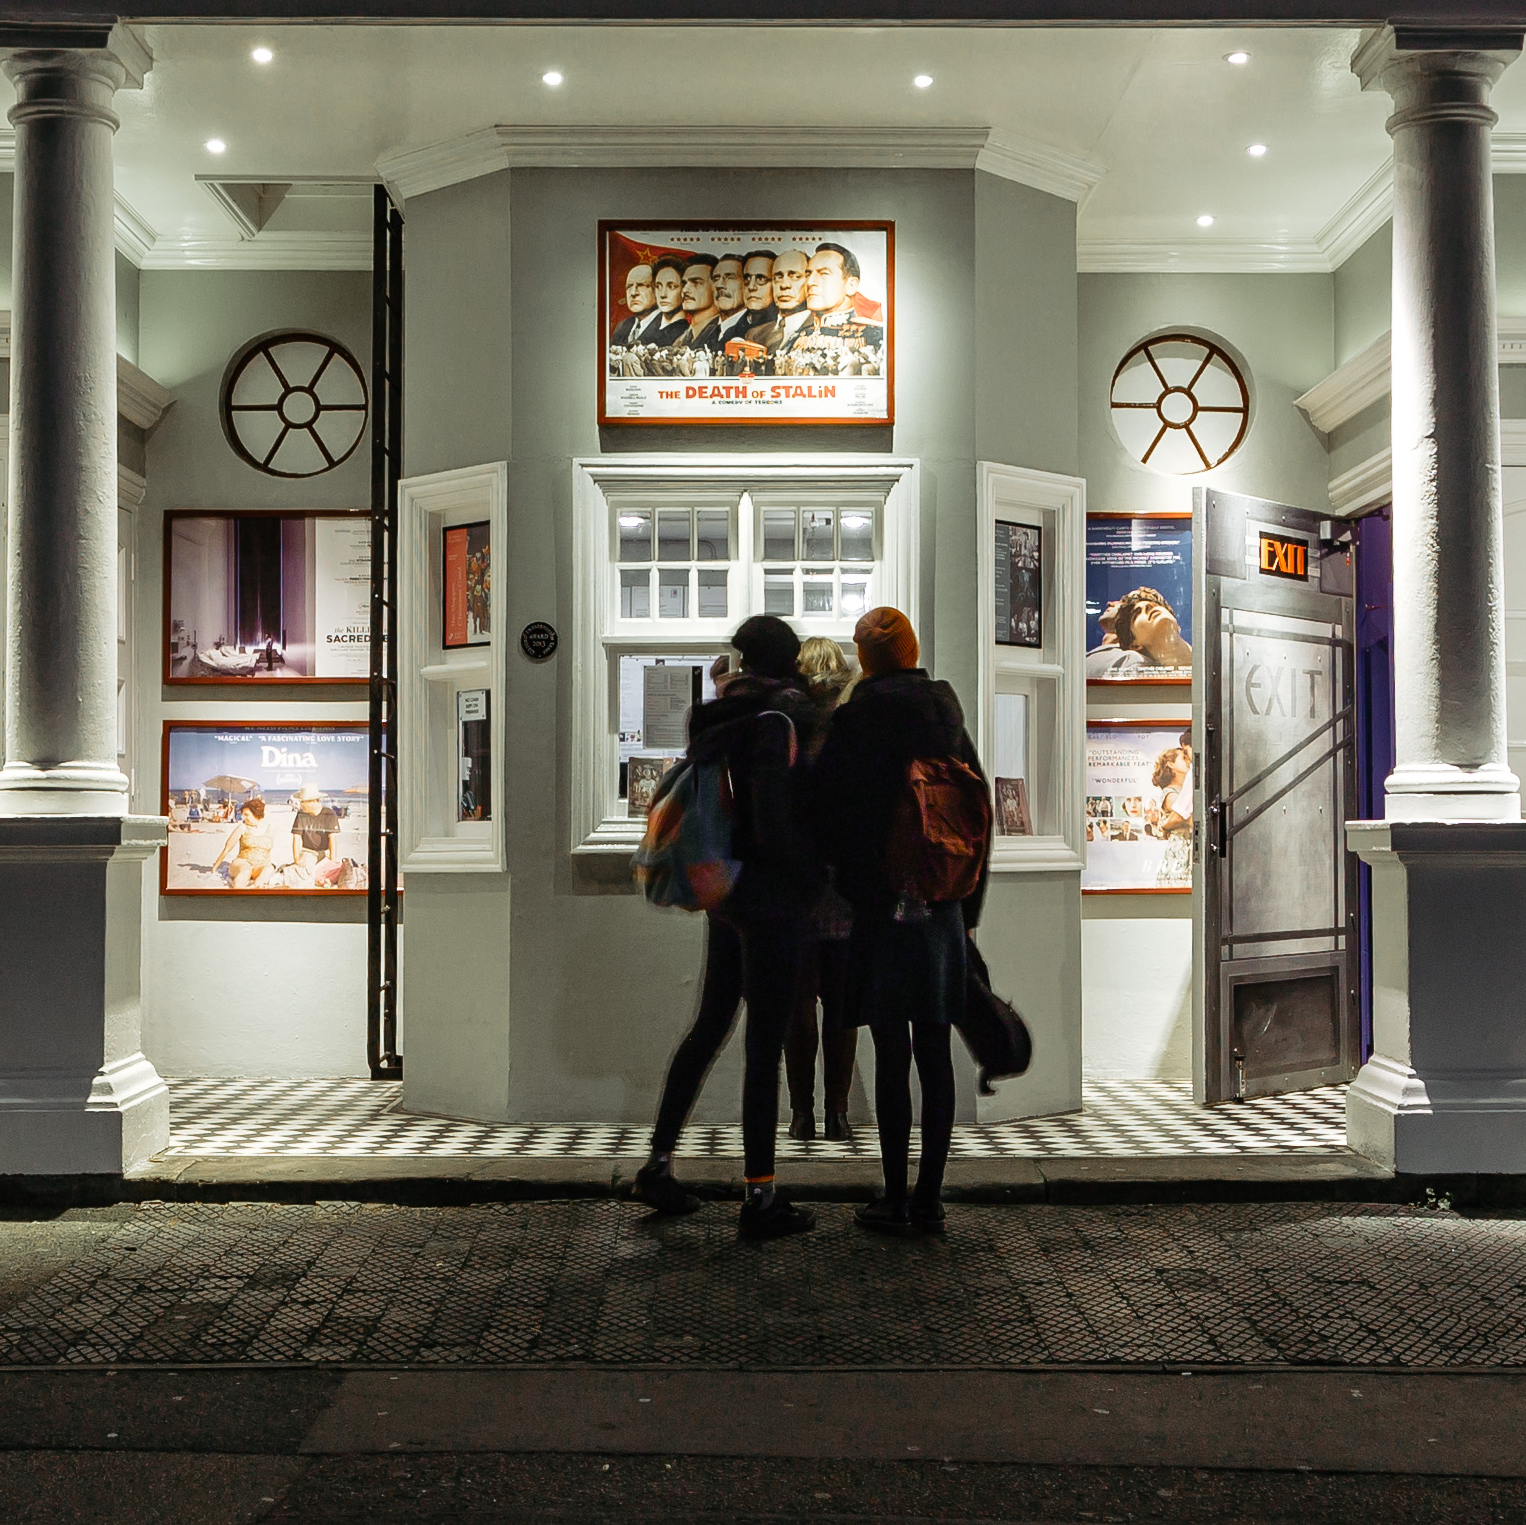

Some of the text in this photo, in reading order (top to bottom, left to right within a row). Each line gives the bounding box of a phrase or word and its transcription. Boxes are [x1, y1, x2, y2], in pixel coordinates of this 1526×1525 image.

[658, 390, 681, 399] THE
[685, 385, 748, 399] DEATH
[751, 390, 766, 399] OF
[1260, 537, 1307, 576] EXIT
[326, 634, 371, 643] SACRED
[1245, 664, 1323, 719] EXIT
[260, 745, 319, 768] Dina
